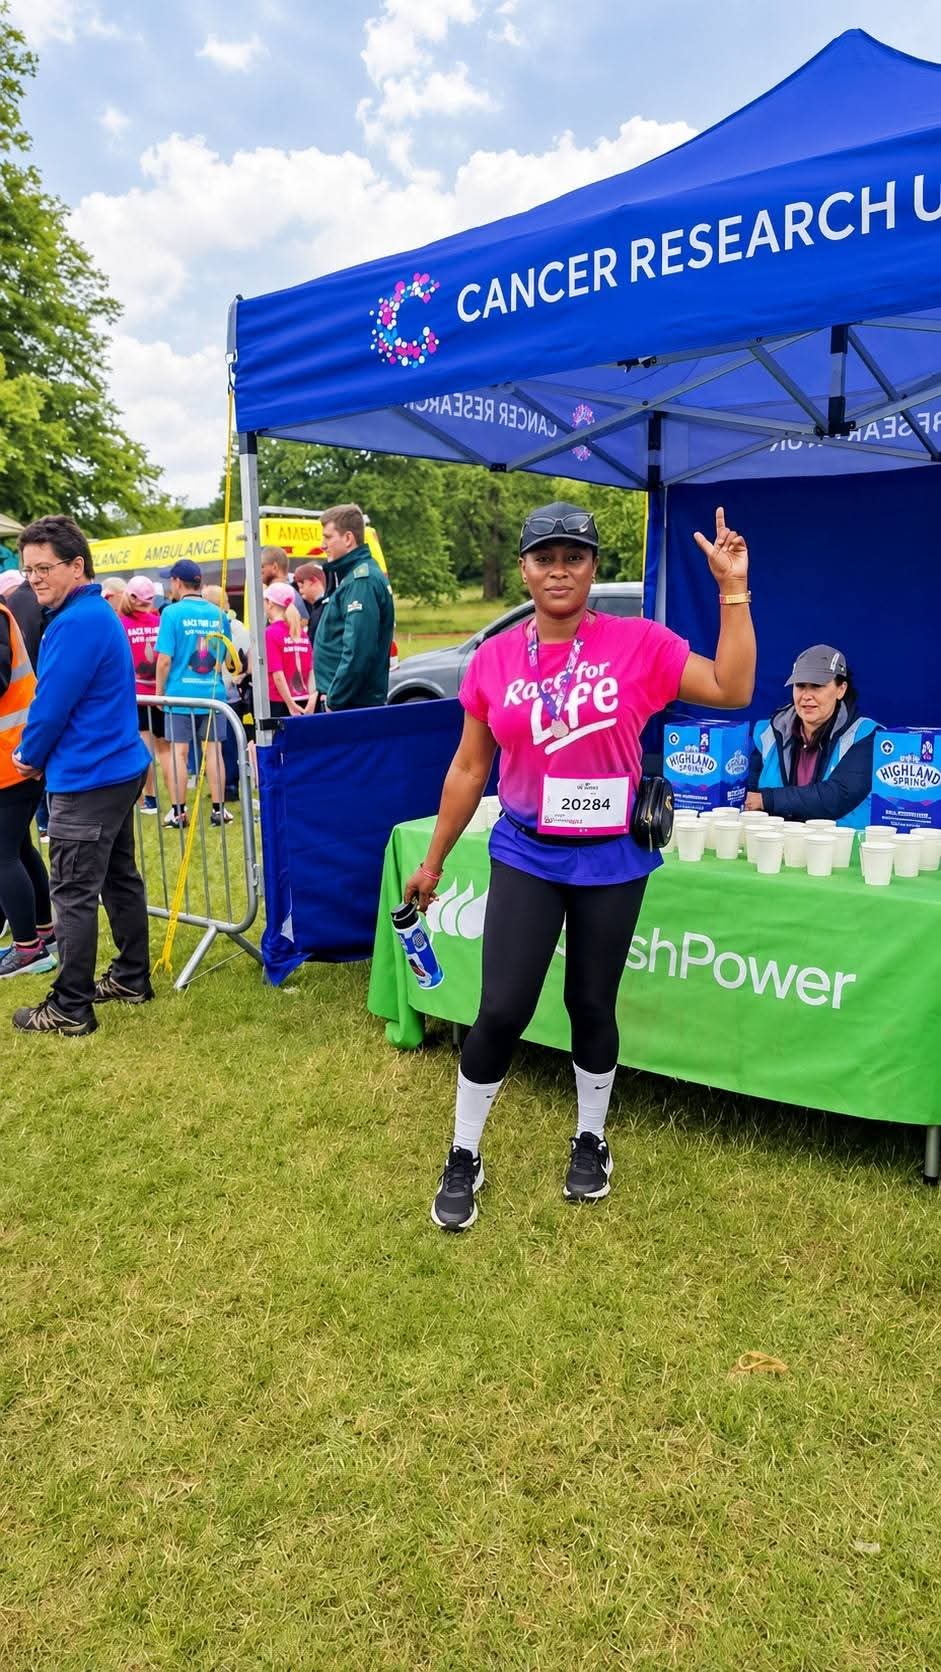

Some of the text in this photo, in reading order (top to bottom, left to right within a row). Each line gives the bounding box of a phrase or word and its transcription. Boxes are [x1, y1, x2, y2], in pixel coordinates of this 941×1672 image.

[457, 247, 618, 323] CANCER
[630, 180, 897, 283] RESEARCH
[143, 538, 221, 561] AMBULANCE
[574, 661, 611, 683] for
[530, 677, 619, 746] Lfe
[669, 753, 715, 771] HIGHLAND
[880, 764, 941, 785] HIGHLAND
[893, 776, 926, 787] SPRING
[561, 797, 611, 811] 20284
[624, 927, 857, 1010] shPower
